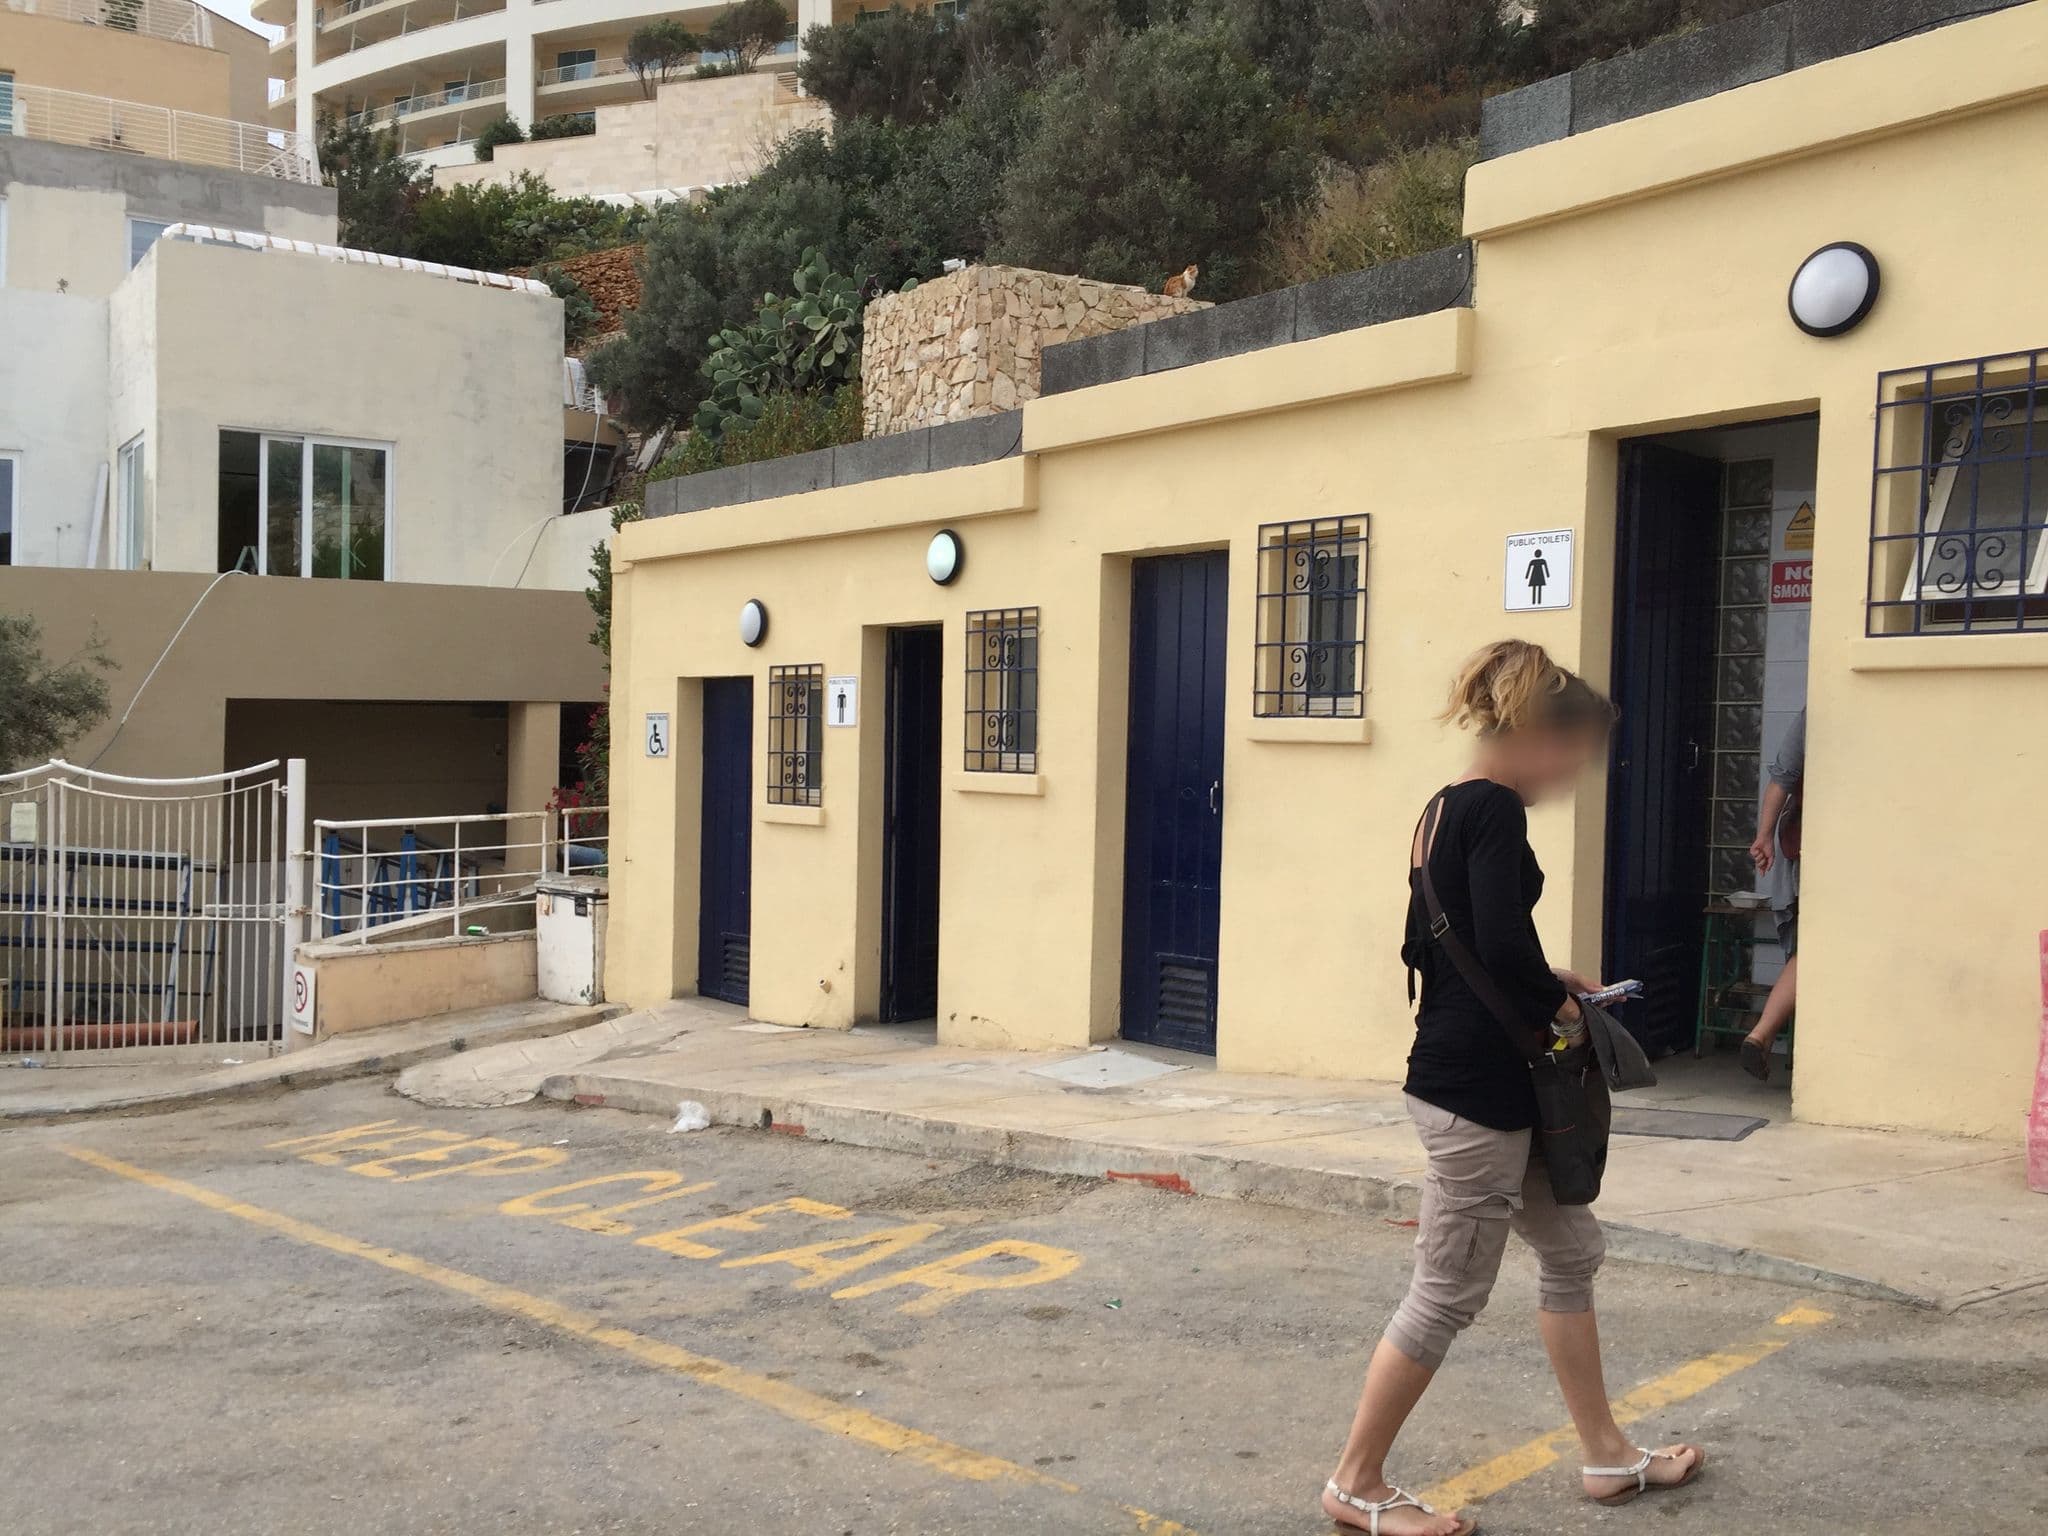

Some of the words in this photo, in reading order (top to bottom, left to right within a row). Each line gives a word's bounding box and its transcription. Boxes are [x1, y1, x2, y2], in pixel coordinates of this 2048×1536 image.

[1508, 537, 1536, 547] PUBLIC
[1537, 533, 1570, 545] TOILETS
[1784, 565, 1813, 581] NO
[262, 1118, 569, 1184] KEEP
[500, 1169, 1084, 1318] CLEAR
